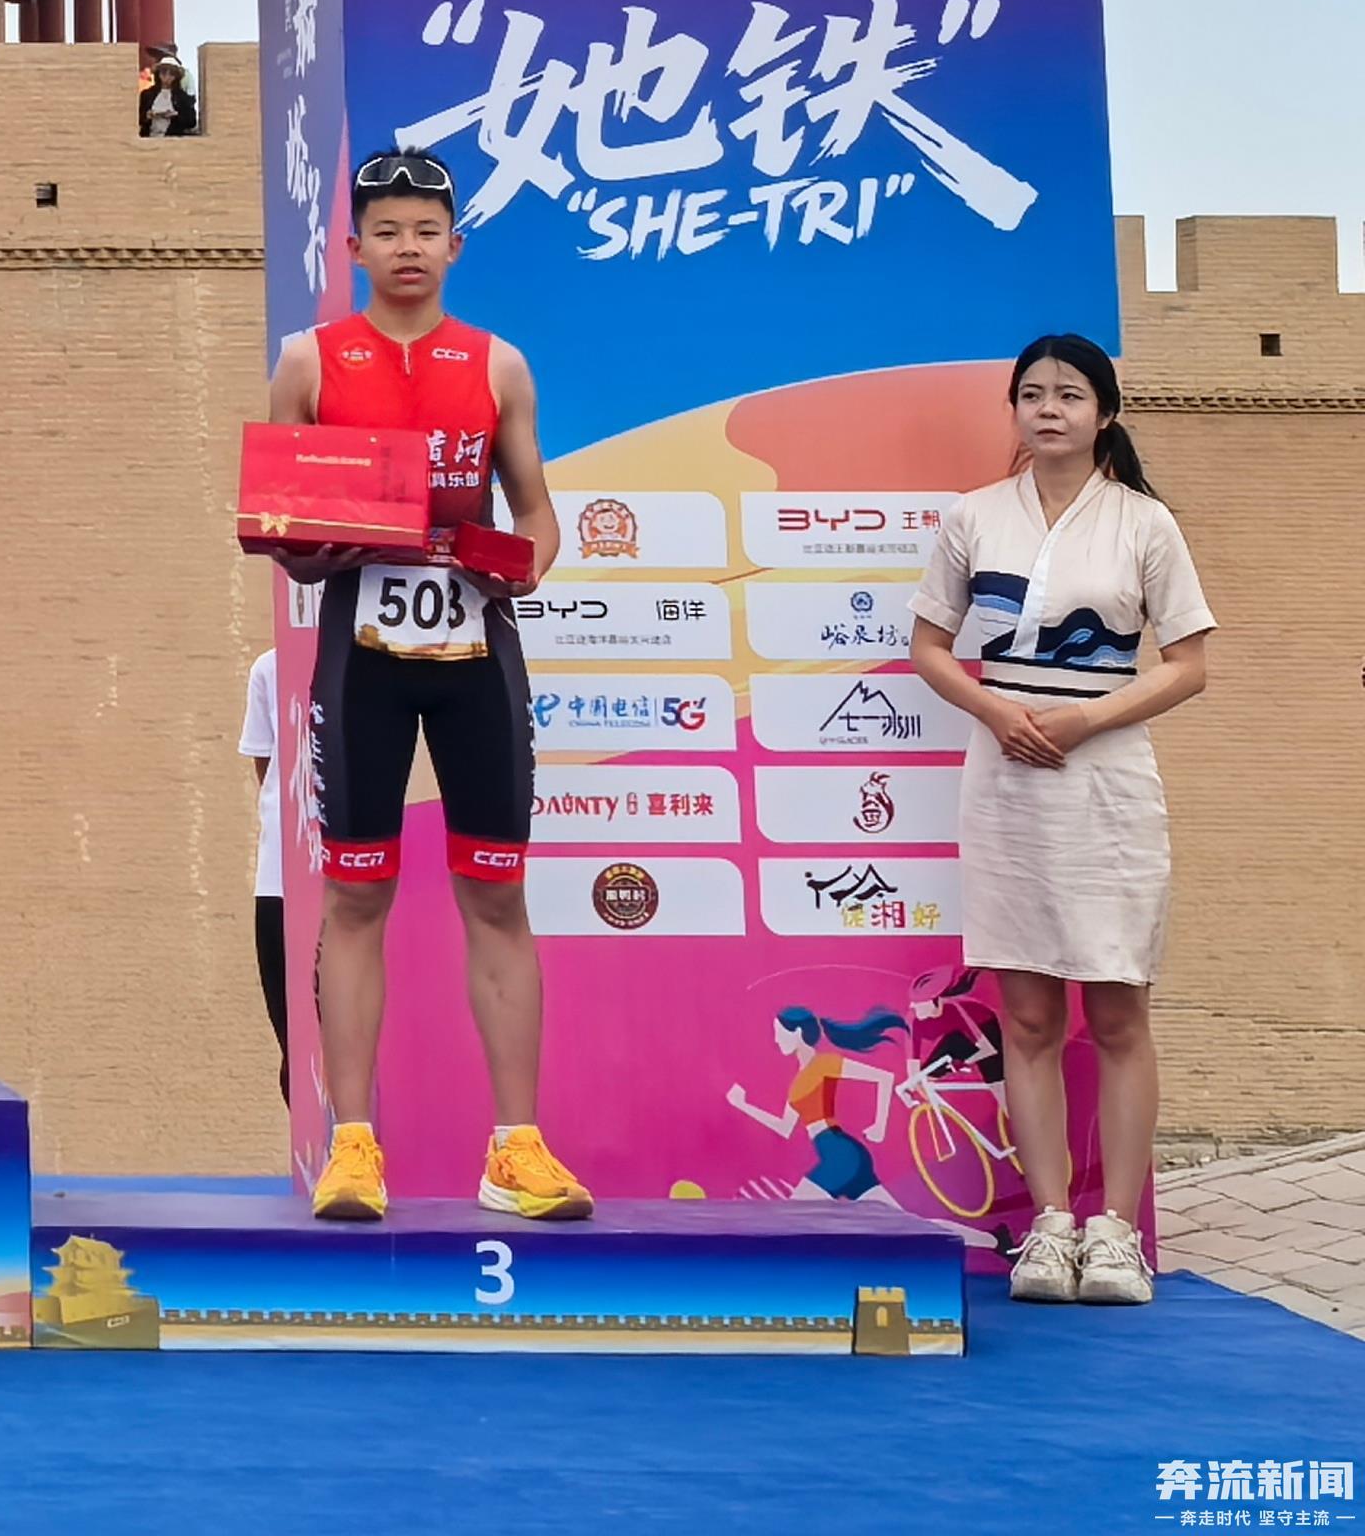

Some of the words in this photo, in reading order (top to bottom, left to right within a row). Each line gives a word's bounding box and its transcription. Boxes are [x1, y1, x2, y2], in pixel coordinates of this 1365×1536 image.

[567, 173, 916, 261] “SHE-TRI”
[777, 509, 886, 531] BYD
[378, 576, 466, 630] 503
[517, 600, 608, 619] BYD
[568, 695, 650, 718] 中国电信
[661, 696, 707, 730] 5G
[646, 792, 714, 816] 喜利来
[475, 1240, 515, 1305] 3
